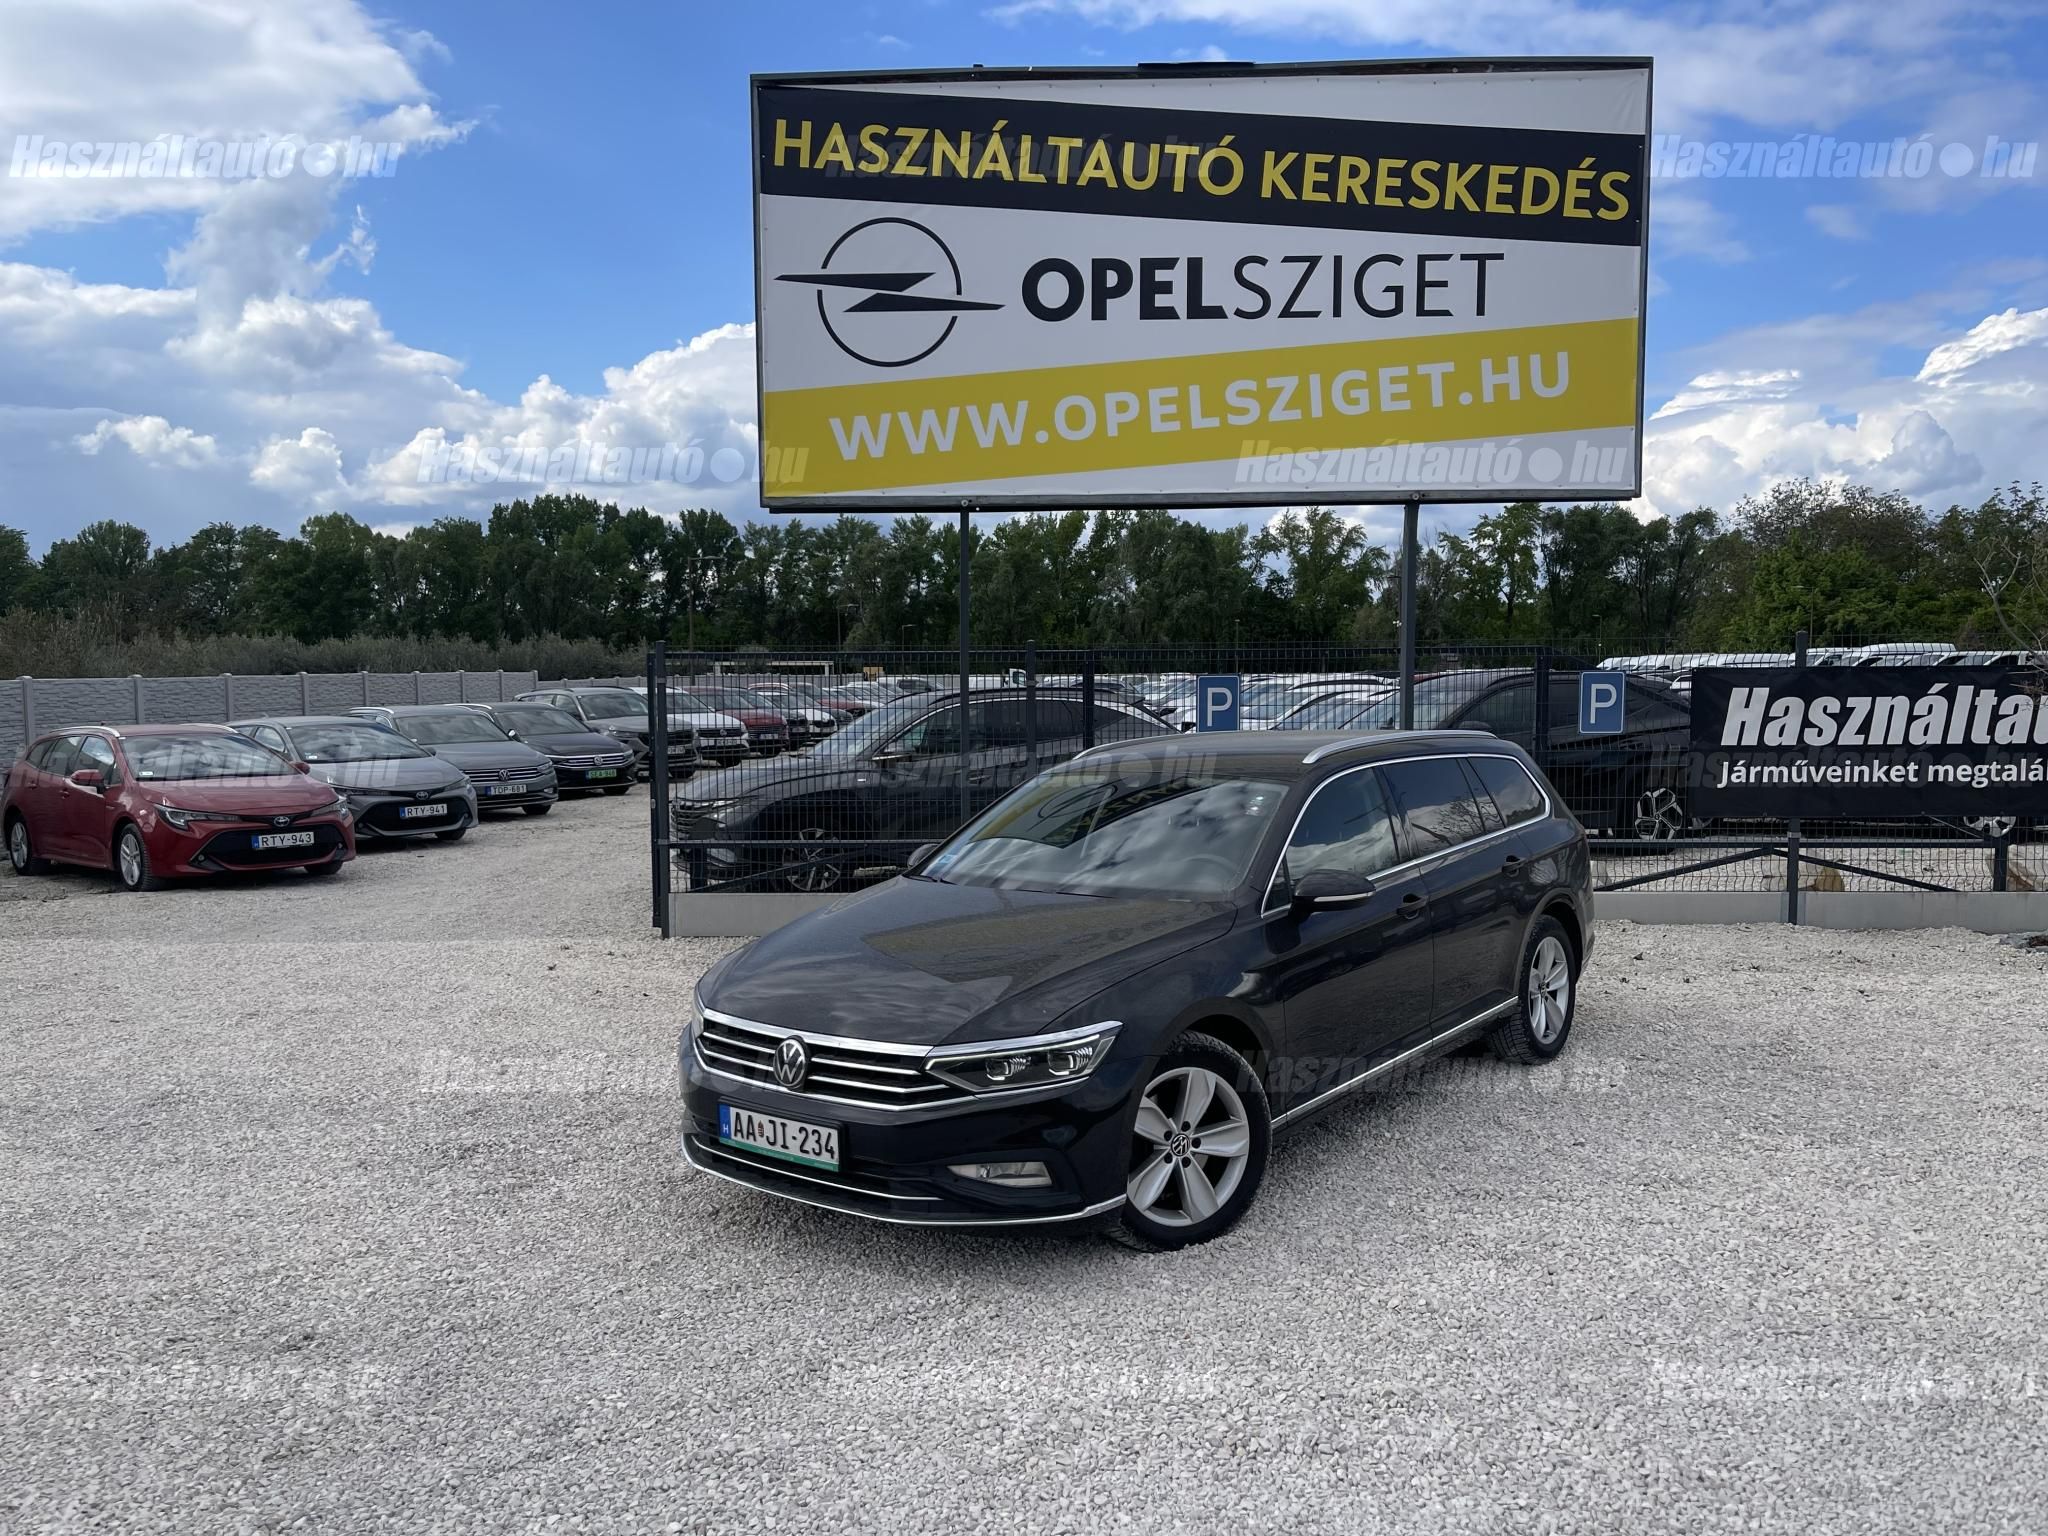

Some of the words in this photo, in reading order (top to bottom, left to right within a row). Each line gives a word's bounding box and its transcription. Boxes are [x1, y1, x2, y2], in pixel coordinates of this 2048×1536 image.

[773, 119, 1245, 196] HASZNÁLTAUTÓ
[1260, 150, 1631, 221] KERESKEDÉS
[1021, 252, 1505, 323] OPELSZIGET
[828, 351, 1571, 461] WWW.OPELSZIGET.HU
[1207, 687, 1233, 727] P
[1590, 683, 1618, 724] P
[1717, 759, 1919, 789] Járműveinket
[1927, 758, 2048, 789] megtalá
[407, 805, 447, 816] RTY-941
[262, 833, 312, 846] RTY-943
